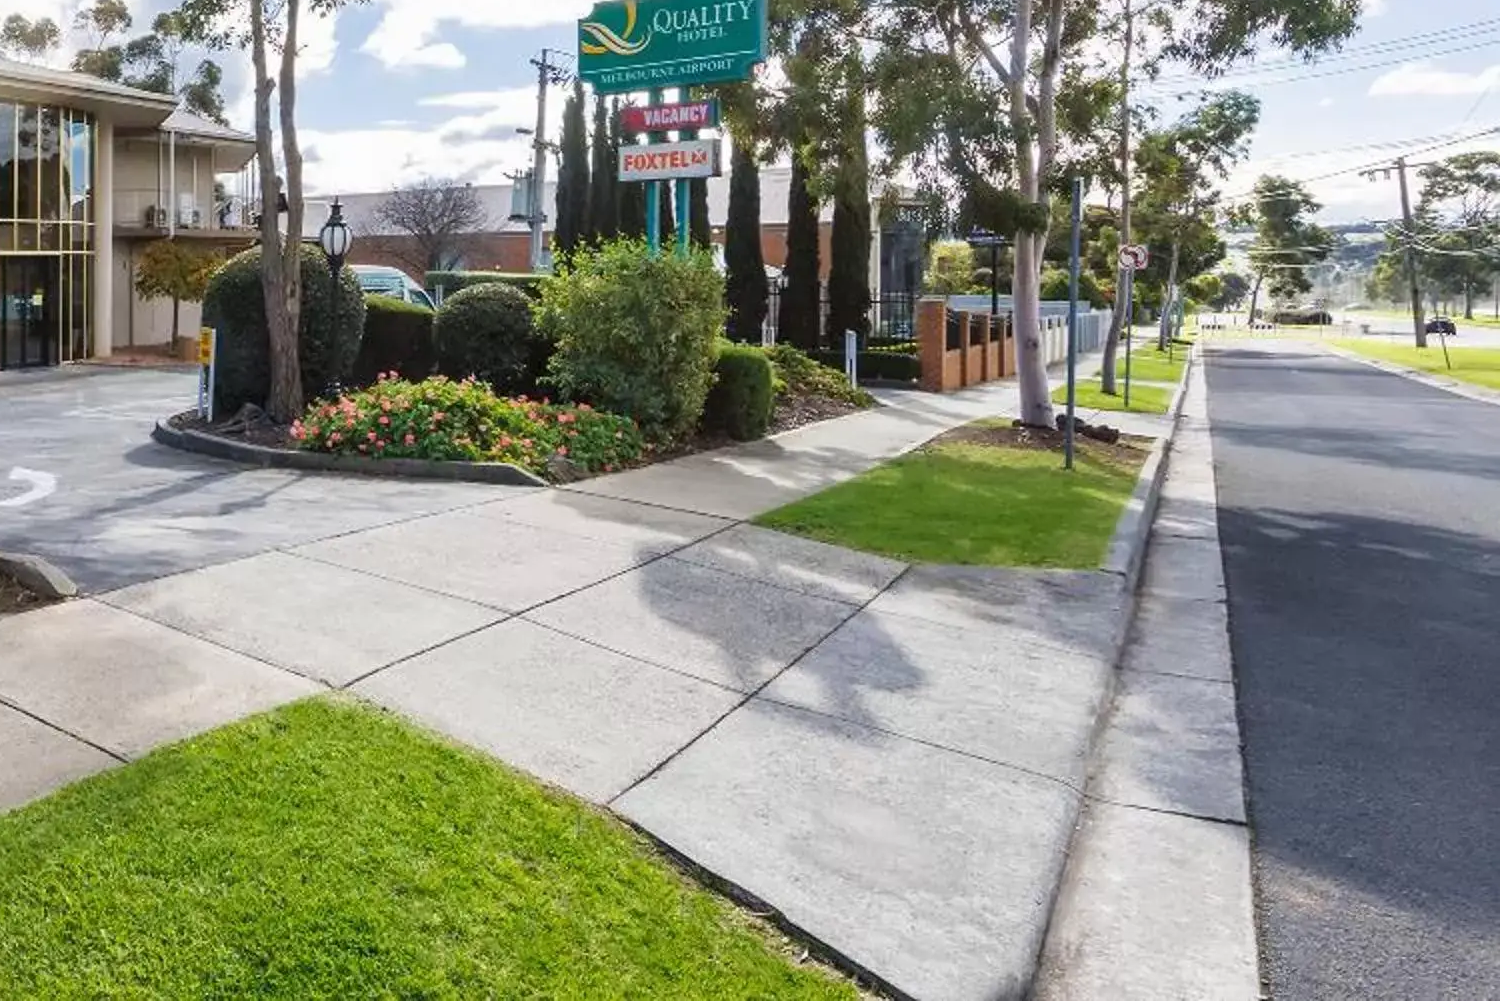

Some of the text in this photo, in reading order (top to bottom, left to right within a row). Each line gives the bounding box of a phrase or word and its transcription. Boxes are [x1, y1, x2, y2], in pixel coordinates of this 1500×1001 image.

[653, 0, 755, 33] QUALITY
[677, 26, 727, 42] HOTEL
[600, 58, 734, 84] MELBOURNE AIRPORT
[643, 104, 708, 127] VACANCY
[623, 150, 690, 172] FOXTEL
